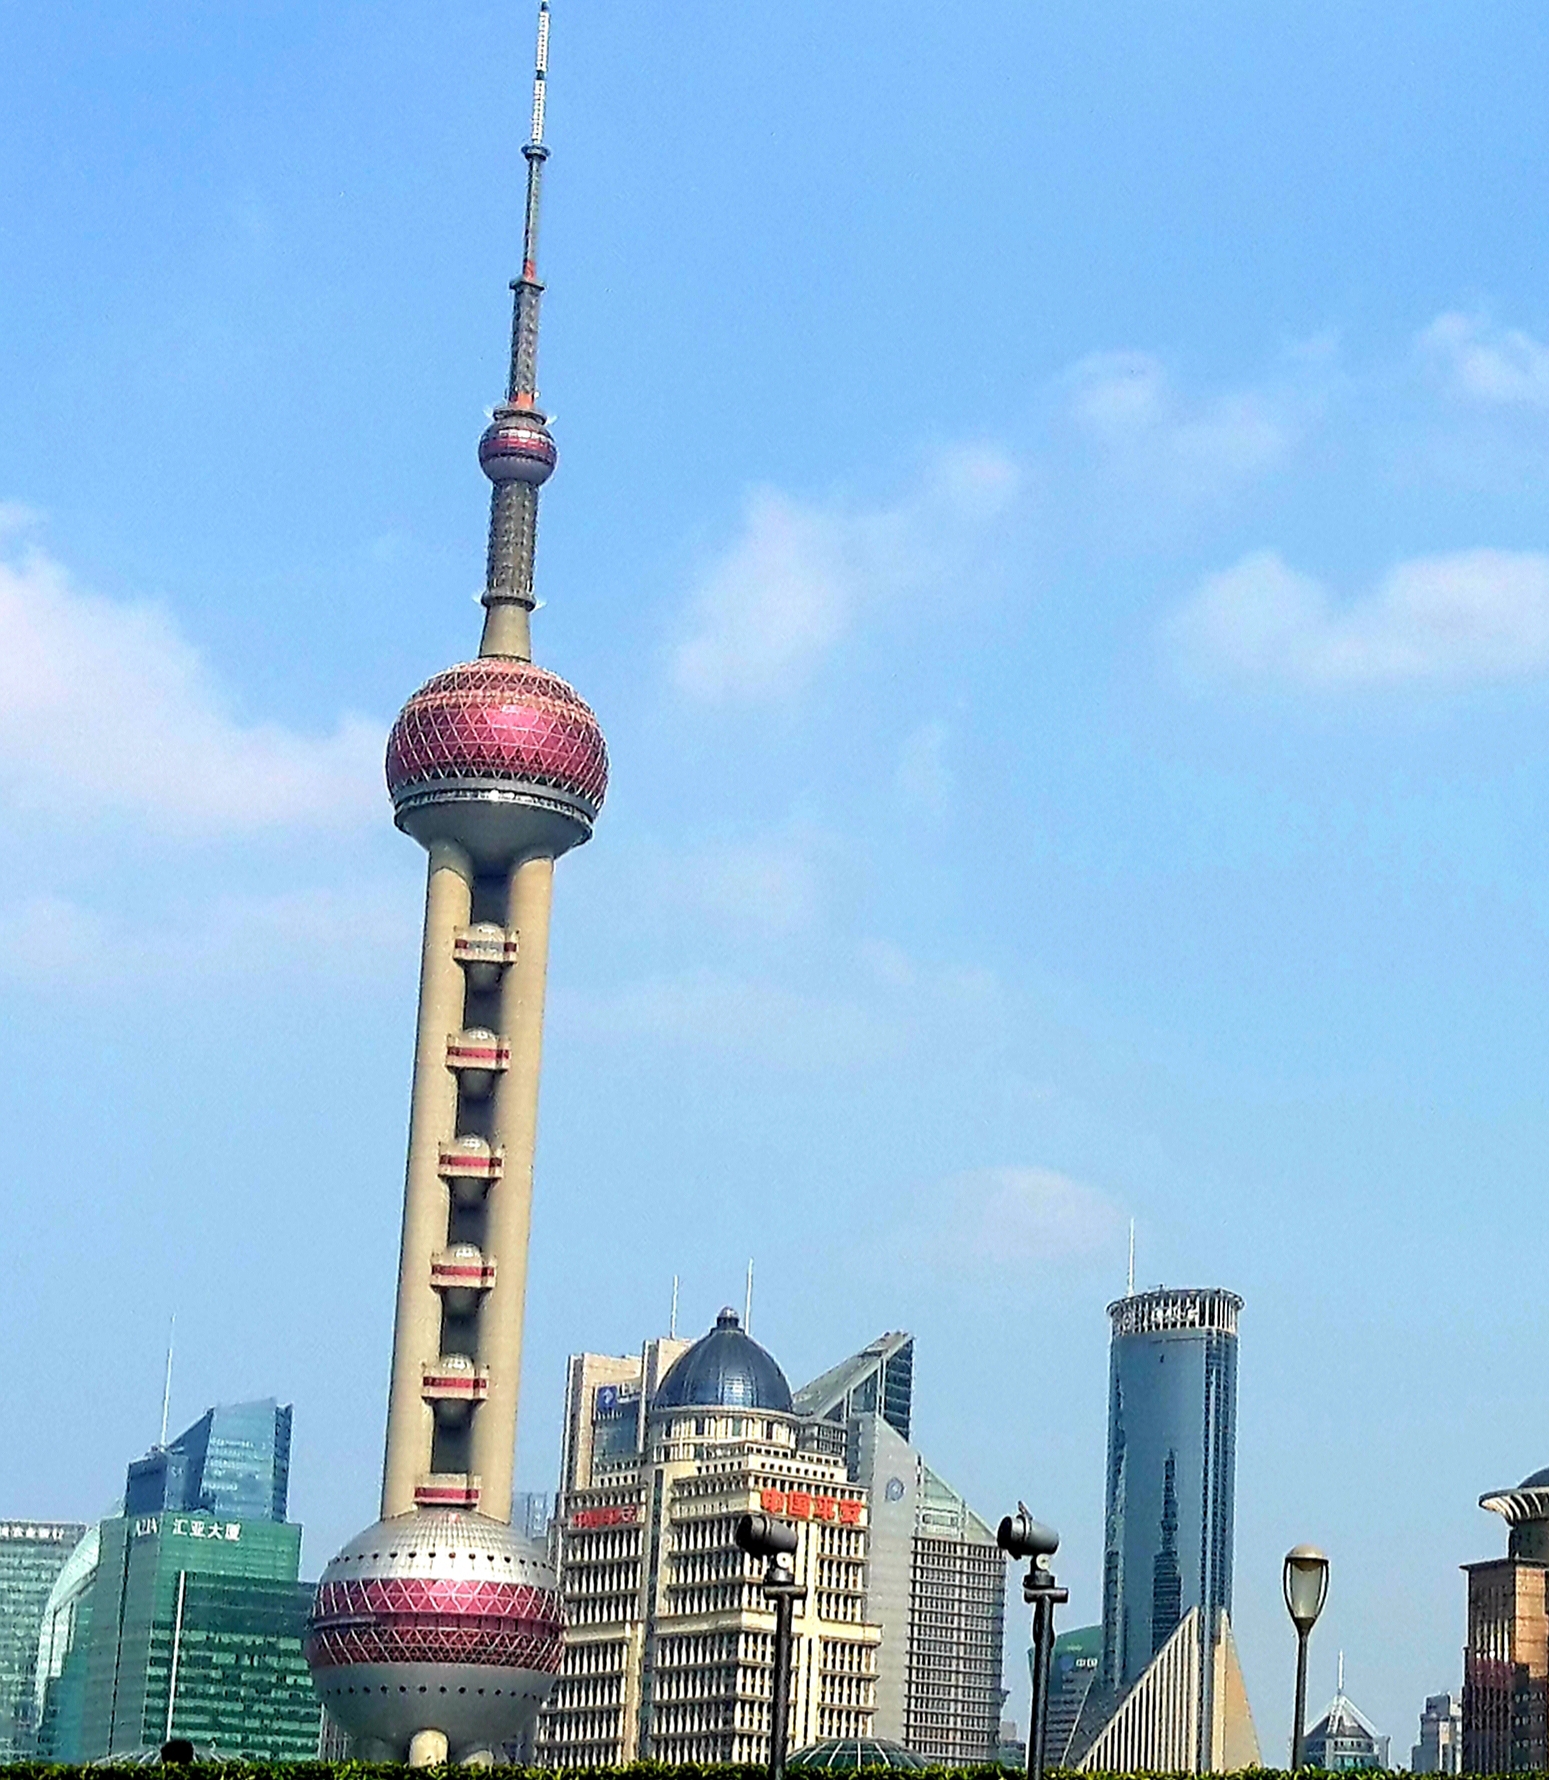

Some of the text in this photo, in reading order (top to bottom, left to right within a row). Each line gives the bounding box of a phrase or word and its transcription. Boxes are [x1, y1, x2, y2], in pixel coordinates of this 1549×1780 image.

[760, 1486, 863, 1525] 中国平安
[172, 1517, 242, 1542] 汇亚大厦
